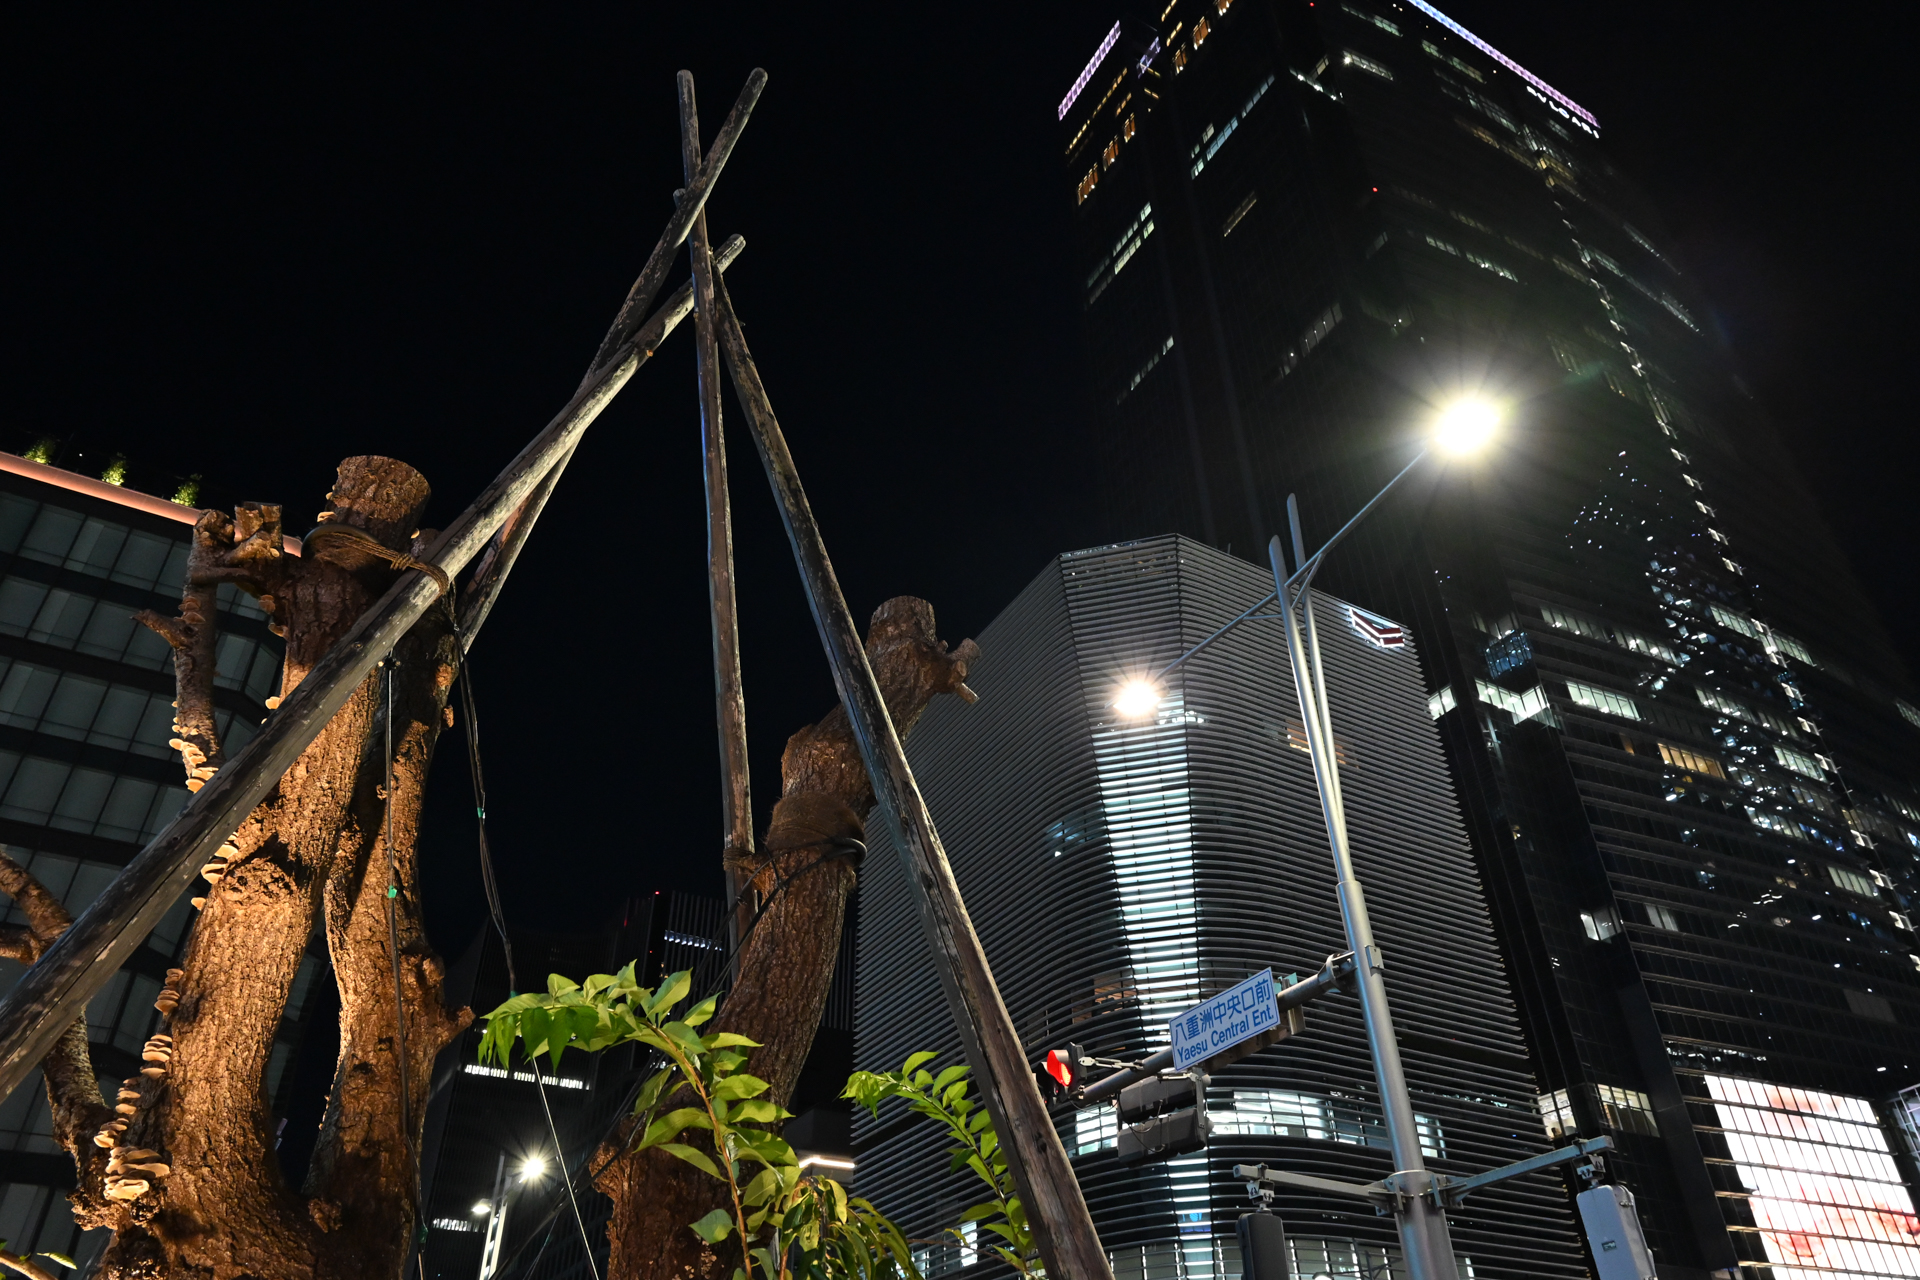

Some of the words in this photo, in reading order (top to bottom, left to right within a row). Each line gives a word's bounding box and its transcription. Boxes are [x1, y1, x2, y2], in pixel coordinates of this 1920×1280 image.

[1175, 978, 1271, 1046] 八重洲中央口前
[1177, 1039, 1208, 1063] Yaesu
[1211, 1014, 1250, 1047] Central
[1252, 1004, 1275, 1027] Ent.
